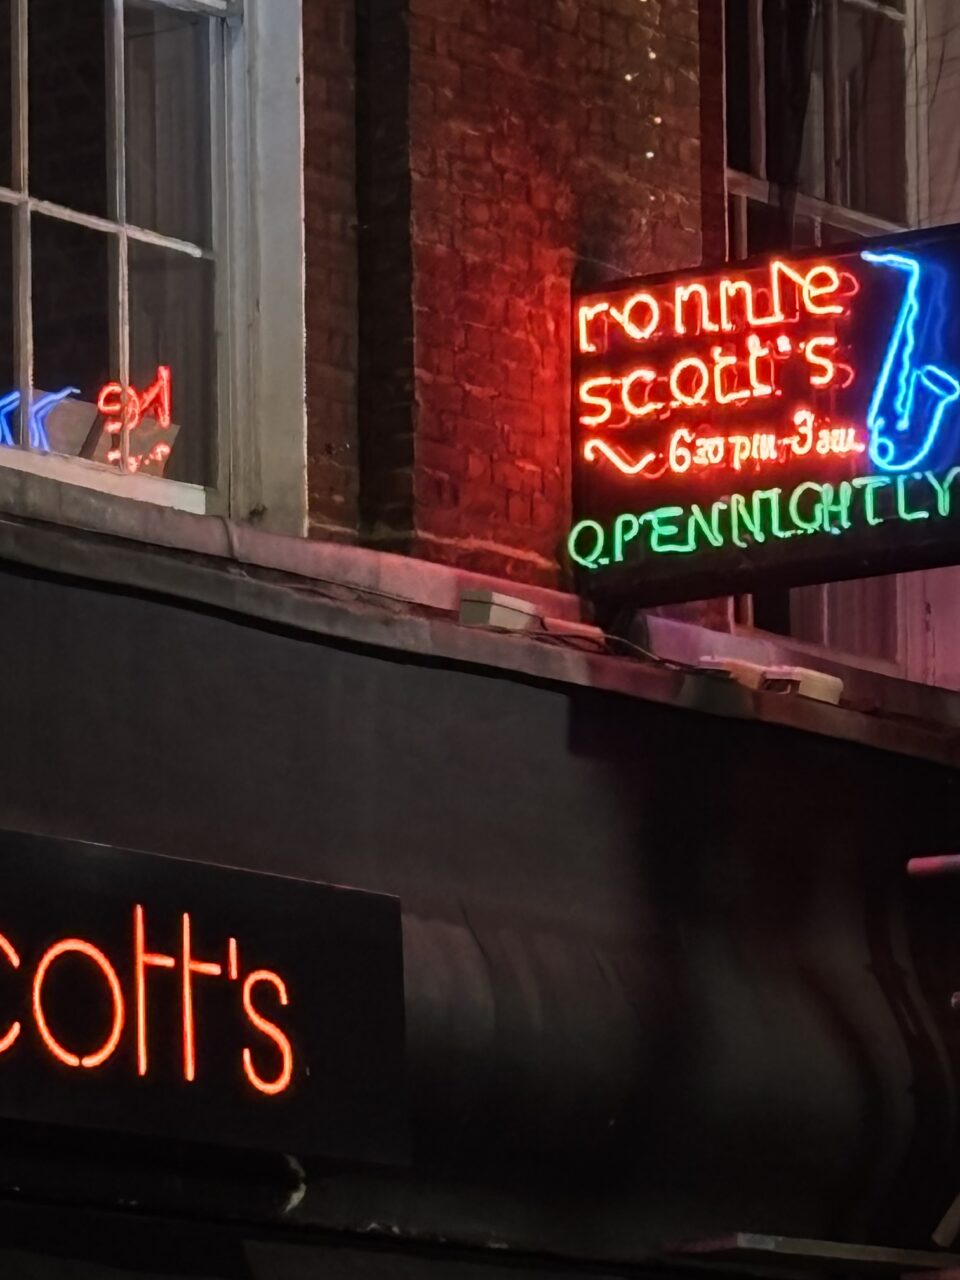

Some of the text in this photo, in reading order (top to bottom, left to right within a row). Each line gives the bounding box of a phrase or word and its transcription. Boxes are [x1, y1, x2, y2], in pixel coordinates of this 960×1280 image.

[578, 260, 844, 354] ronnie
[578, 333, 838, 427] scott's
[567, 466, 960, 568] OPEN NIGHTLY
